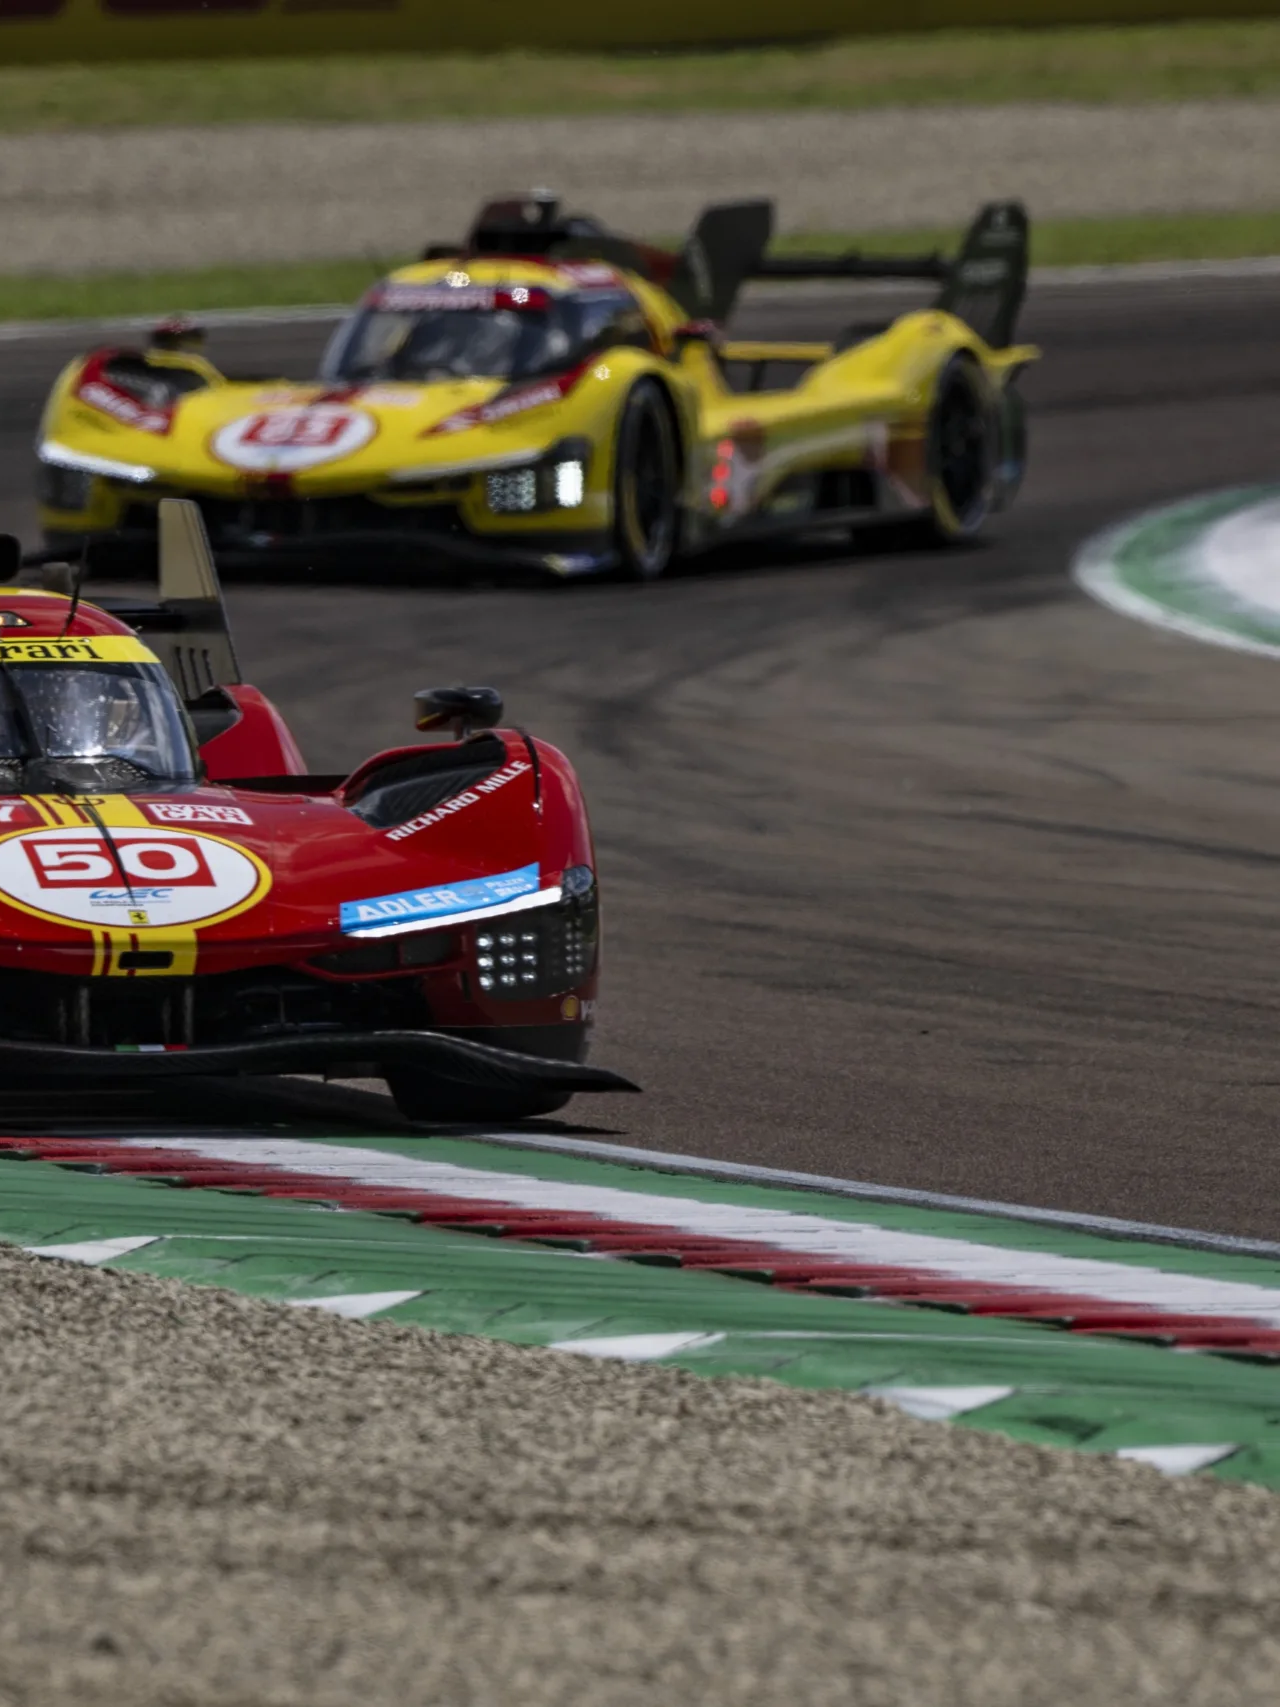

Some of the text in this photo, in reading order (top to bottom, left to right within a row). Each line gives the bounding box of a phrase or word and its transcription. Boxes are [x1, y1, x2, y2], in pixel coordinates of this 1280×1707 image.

[385, 760, 533, 841] RICHARD MILLE
[33, 842, 200, 881] 50
[356, 888, 468, 922] ADLER
